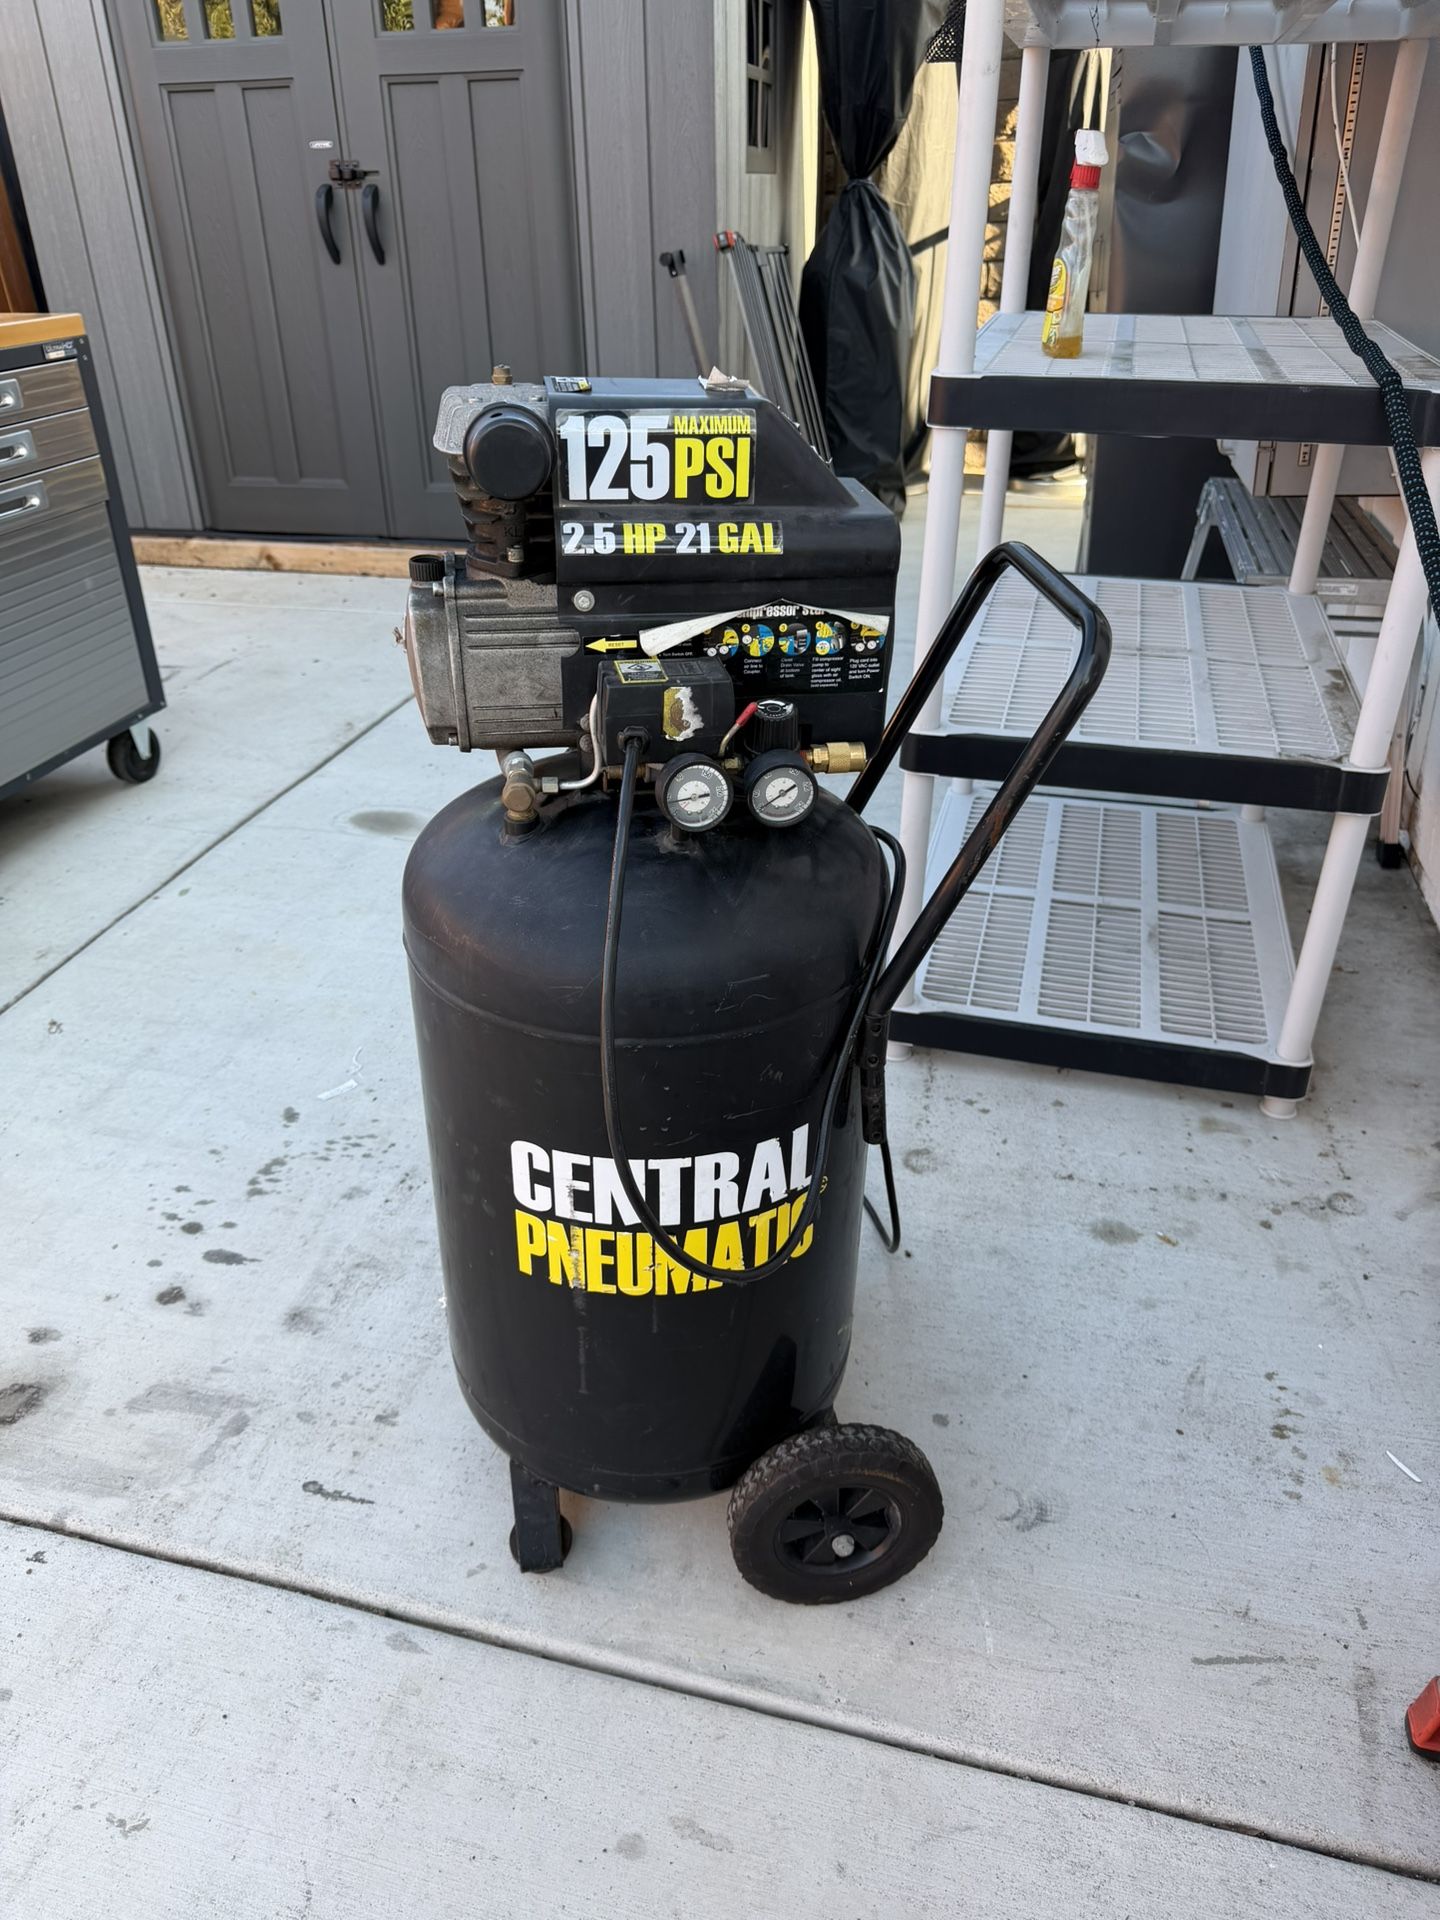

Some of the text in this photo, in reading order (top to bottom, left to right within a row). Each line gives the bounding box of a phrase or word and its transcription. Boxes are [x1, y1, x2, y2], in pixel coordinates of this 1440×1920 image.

[559, 415, 670, 501] 125
[674, 415, 751, 435] MAXIMUM
[674, 437, 751, 499] PSI
[562, 522, 782, 554] 2.5 HP 21 GAL
[511, 1123, 813, 1225] CENTRAL
[515, 1194, 814, 1296] PNEUMATIC
